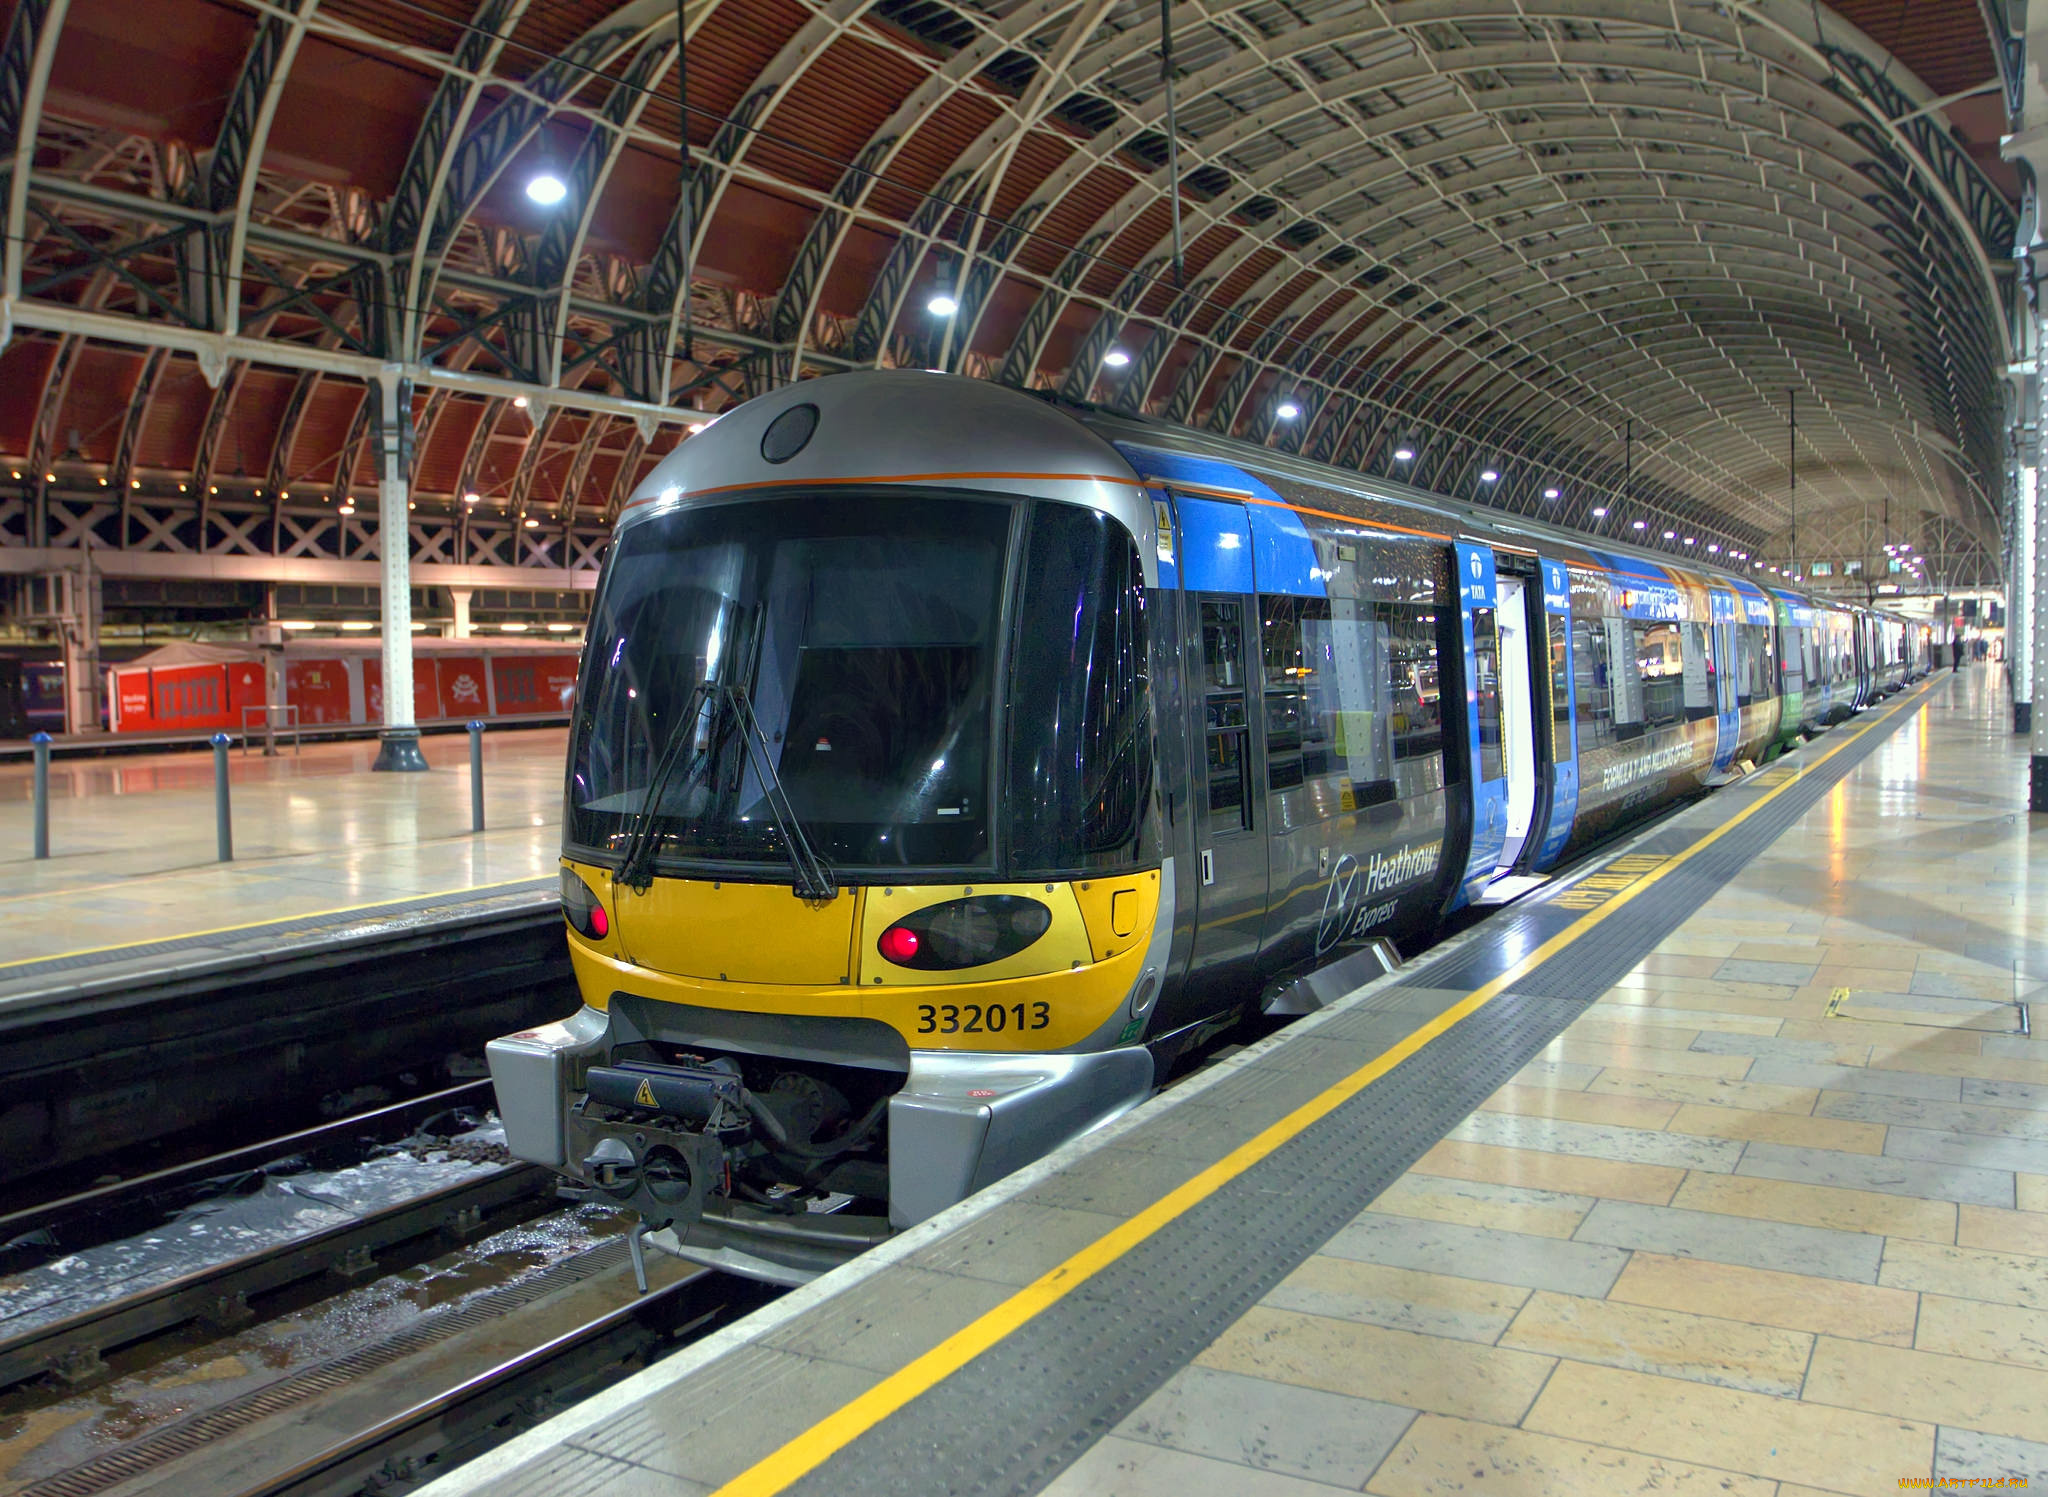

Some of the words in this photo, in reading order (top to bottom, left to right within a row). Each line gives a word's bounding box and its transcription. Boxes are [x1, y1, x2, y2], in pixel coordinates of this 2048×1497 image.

[1471, 584, 1485, 600] TATA
[1365, 844, 1437, 895] Heathrow
[1546, 891, 1613, 909] GAP
[1351, 898, 1399, 936] Express
[917, 1001, 1051, 1034] 332013
